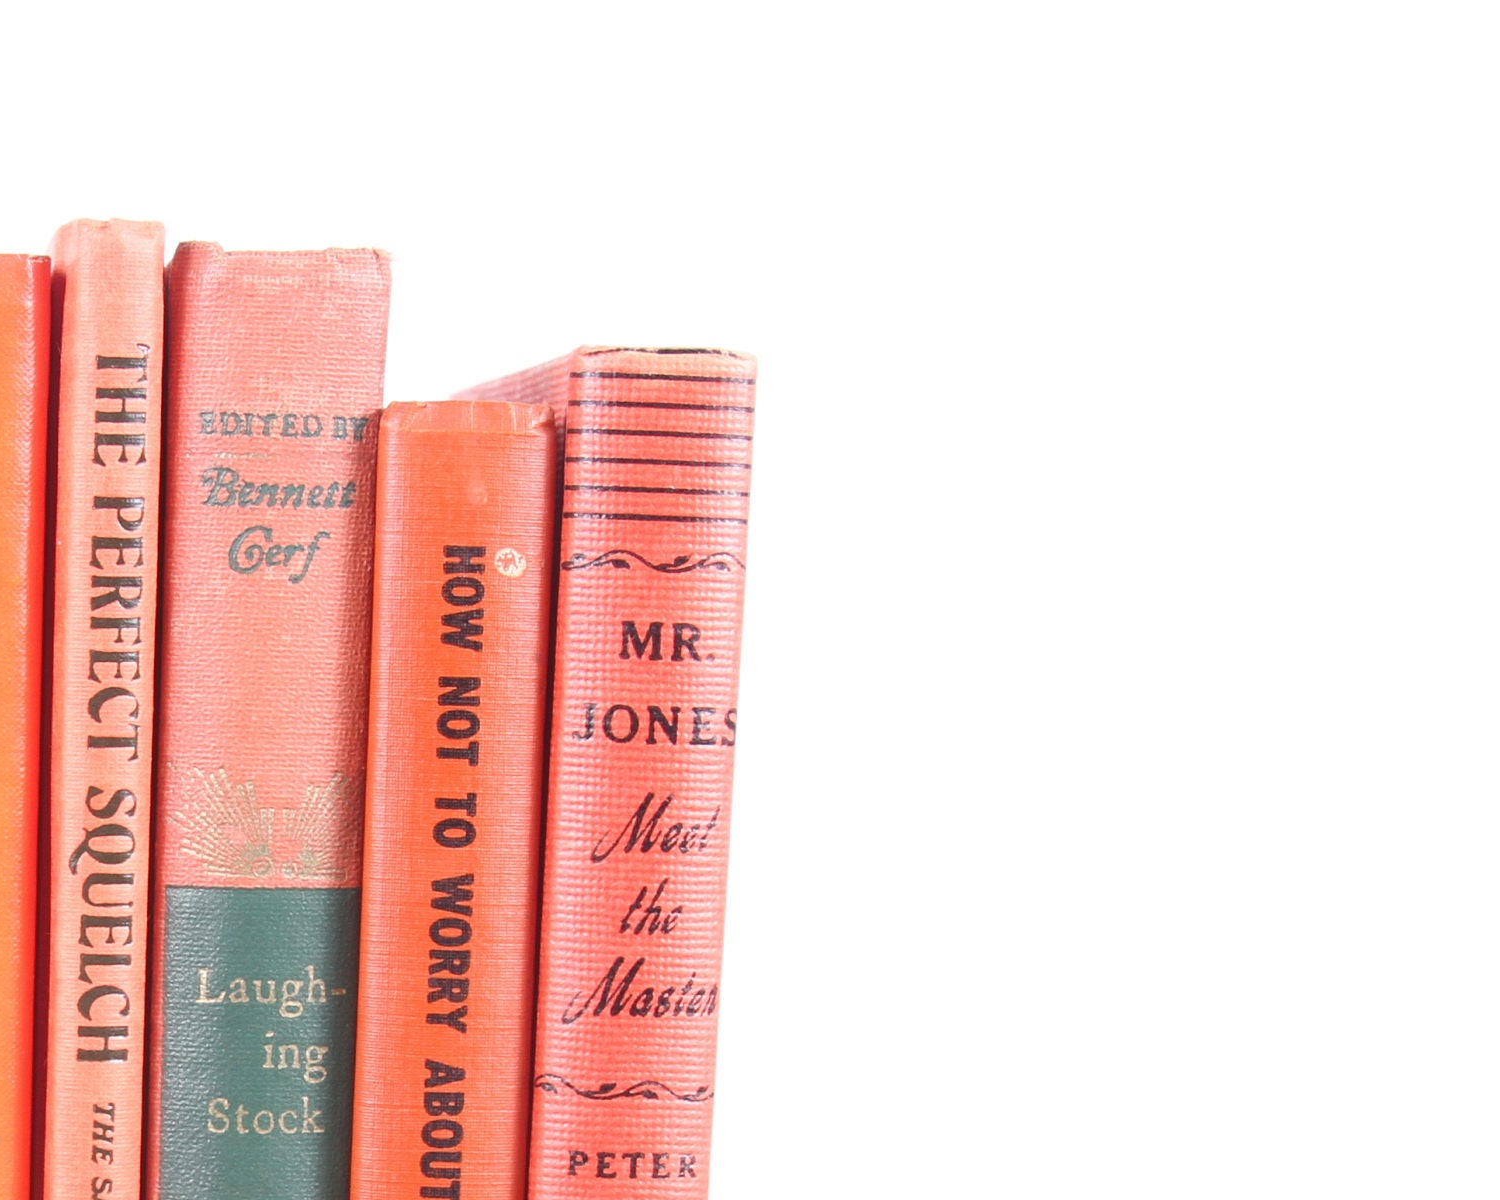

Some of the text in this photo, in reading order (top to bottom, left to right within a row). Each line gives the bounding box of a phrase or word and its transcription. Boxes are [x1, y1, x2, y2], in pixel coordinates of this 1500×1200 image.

[200, 412, 369, 441] EDITED BY
[201, 466, 357, 509] Bennett
[228, 525, 331, 584] Cerf
[441, 544, 487, 652] HOW
[619, 620, 716, 661] MR.
[69, 343, 150, 1062] THE PERFECT SQUELCH
[436, 676, 482, 767] NOT
[572, 703, 737, 746] JONES
[432, 792, 478, 849] TO
[591, 792, 721, 863] Meet
[619, 877, 683, 935] the
[425, 873, 475, 1034] WORRY
[195, 964, 347, 1018] Laugh-
[262, 1030, 329, 1084] ing
[90, 1102, 115, 1165] THE
[207, 1096, 326, 1135] Stock
[567, 1150, 697, 1178] PETER
